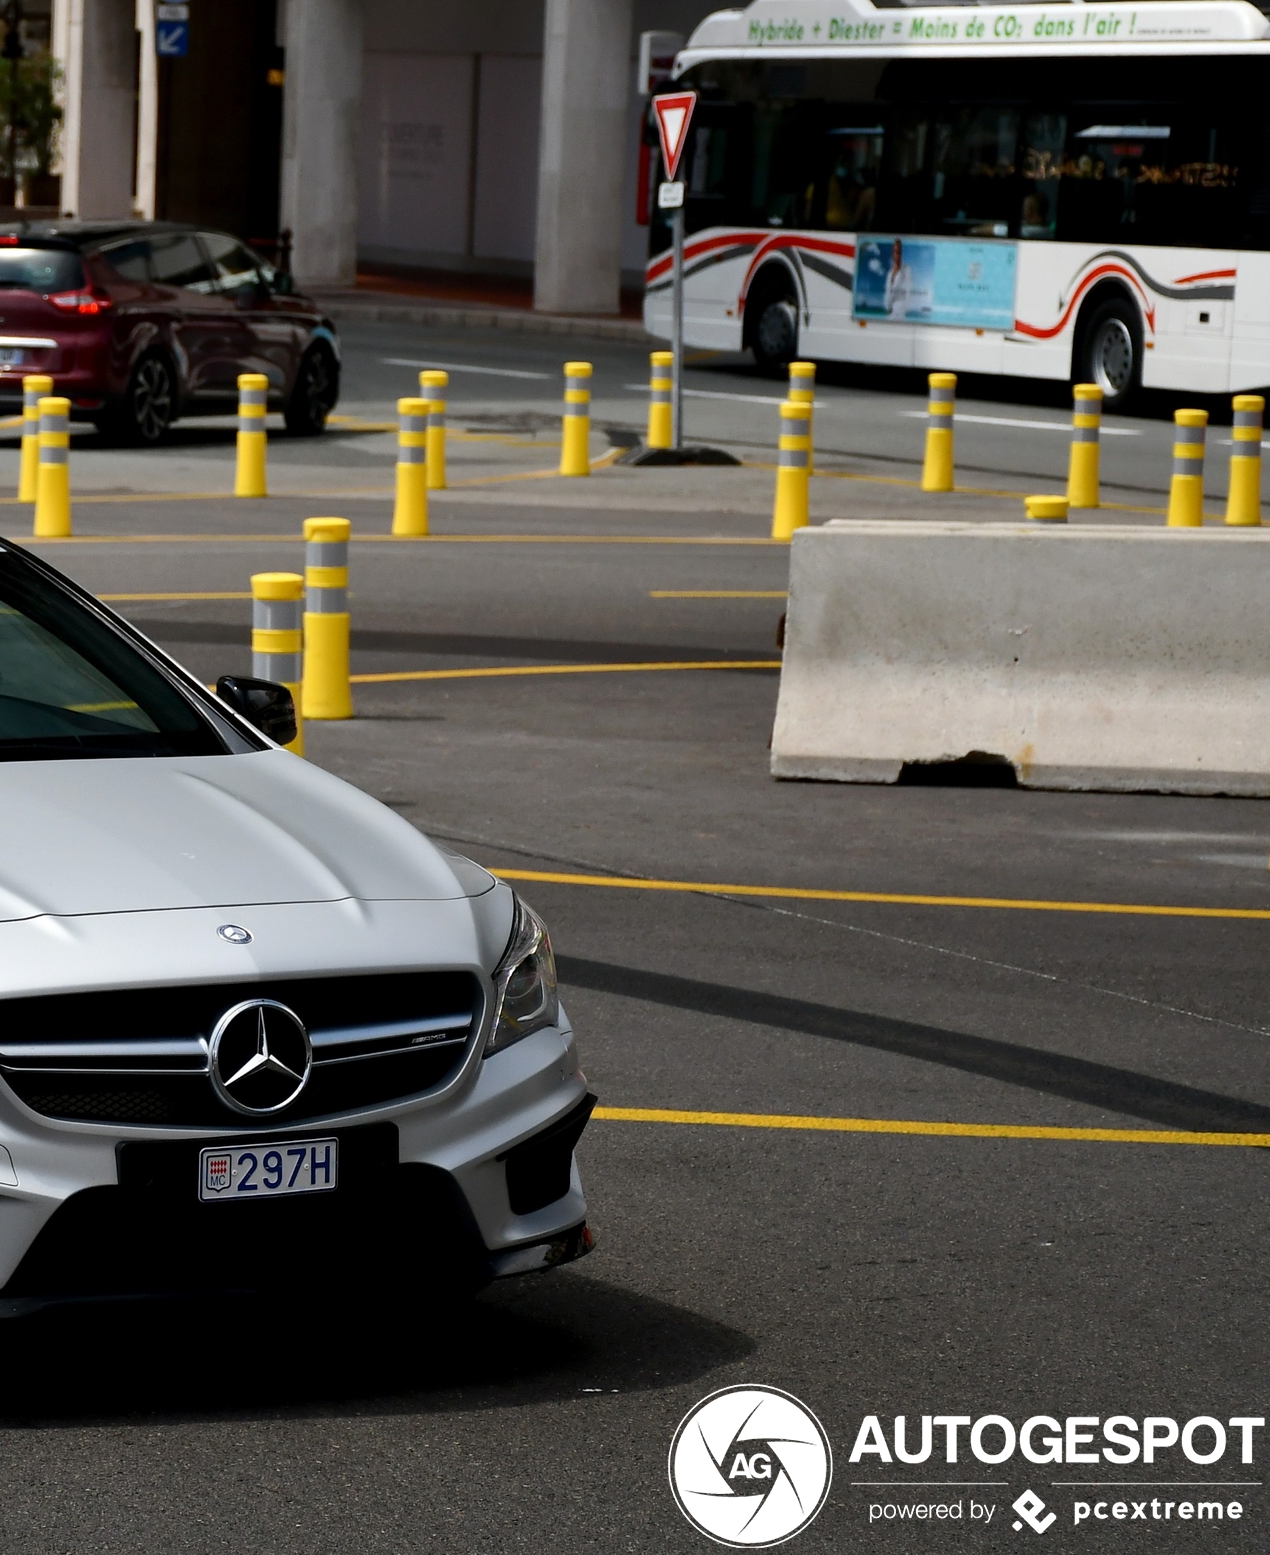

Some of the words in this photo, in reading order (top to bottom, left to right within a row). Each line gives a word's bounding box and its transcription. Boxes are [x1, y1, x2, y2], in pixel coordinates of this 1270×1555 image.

[748, 18, 804, 47] Hybride
[829, 17, 885, 39] Diester
[909, 16, 957, 38] Moins
[965, 15, 985, 38] de
[1034, 13, 1075, 36] dans
[1083, 12, 1122, 36] l'air
[210, 1174, 226, 1187] MC
[237, 1145, 330, 1191] 297H
